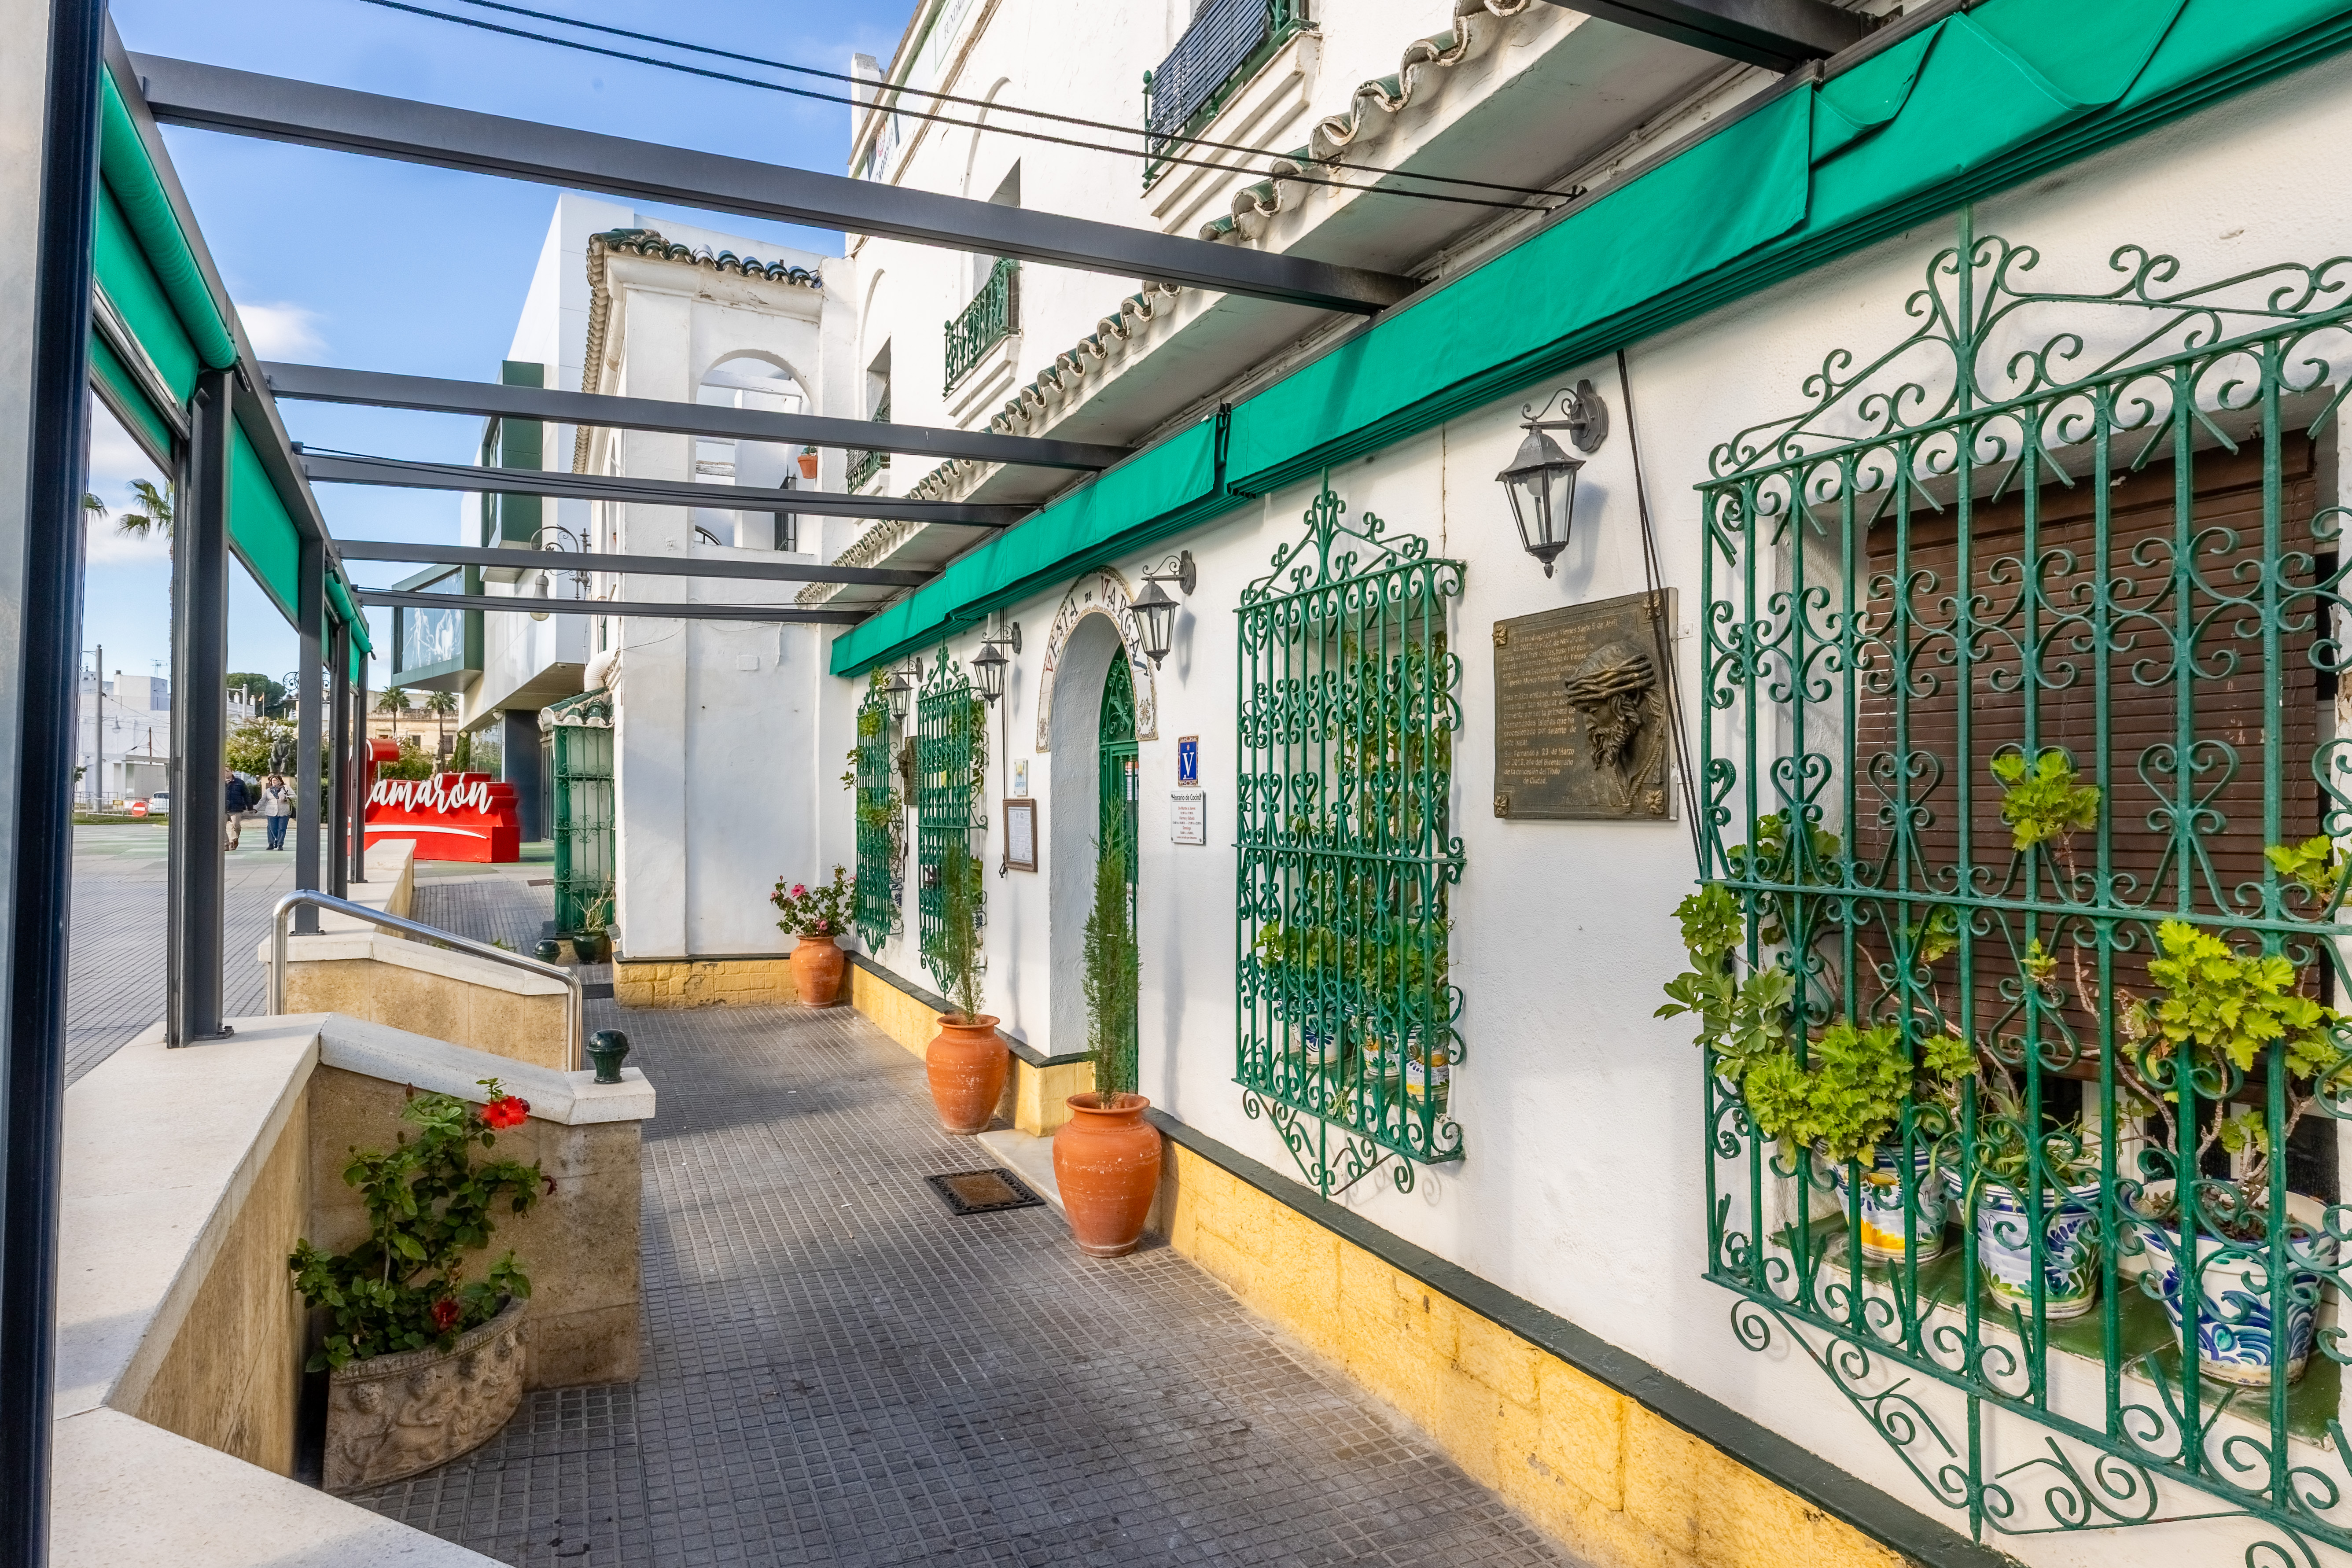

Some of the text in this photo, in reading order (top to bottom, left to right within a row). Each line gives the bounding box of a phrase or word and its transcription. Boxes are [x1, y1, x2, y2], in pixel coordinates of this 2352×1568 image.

[1045, 575, 1149, 677] VENTA DE VARGAS
[1577, 624, 1591, 633] Santo
[1605, 618, 1618, 628] Abril
[1576, 642, 1594, 651] delante
[1547, 707, 1568, 718] primera
[1568, 706, 1576, 714] de
[1556, 718, 1568, 727] que
[1568, 716, 1575, 725] ha
[1547, 726, 1567, 735] delante
[1569, 725, 1576, 734] de
[1514, 749, 1535, 758] Fernando
[1551, 747, 1558, 756] de
[1558, 747, 1575, 756] Marzo
[1182, 752, 1195, 777] V
[1535, 758, 1543, 766] del
[1543, 758, 1574, 766] Bicentenario
[1516, 767, 1539, 776] concesión
[1547, 767, 1561, 776] Título
[365, 740, 493, 815] amarón
